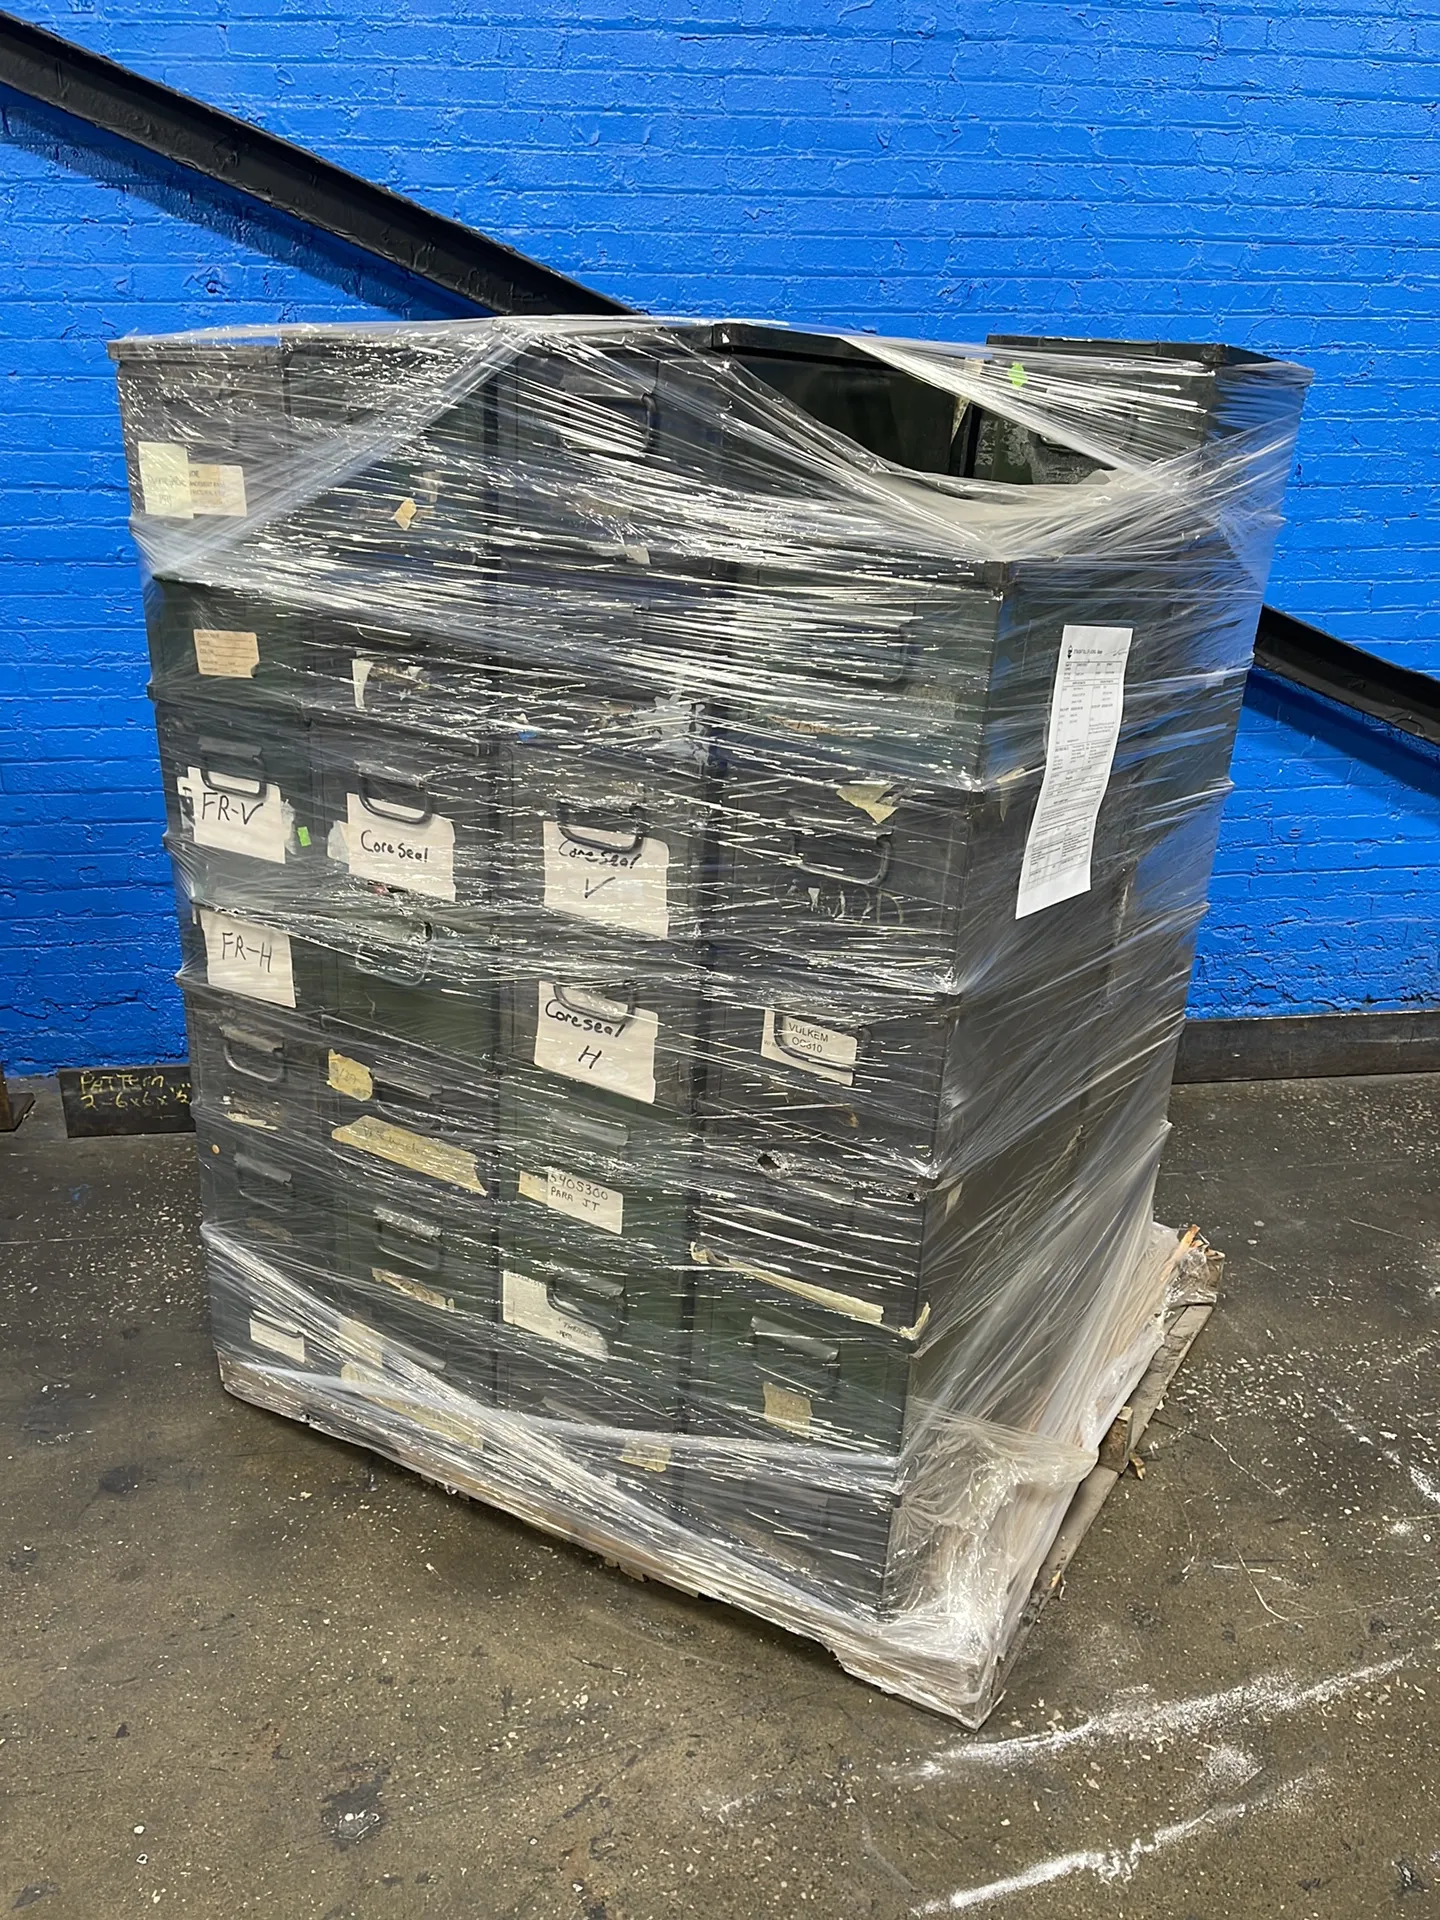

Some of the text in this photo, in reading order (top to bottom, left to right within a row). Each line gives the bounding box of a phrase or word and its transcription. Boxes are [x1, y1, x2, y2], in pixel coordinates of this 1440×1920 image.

[201, 792, 264, 826] FR-V
[221, 932, 272, 973] FR-H
[788, 1022, 829, 1043] VULKEM
[578, 1045, 603, 1070] H
